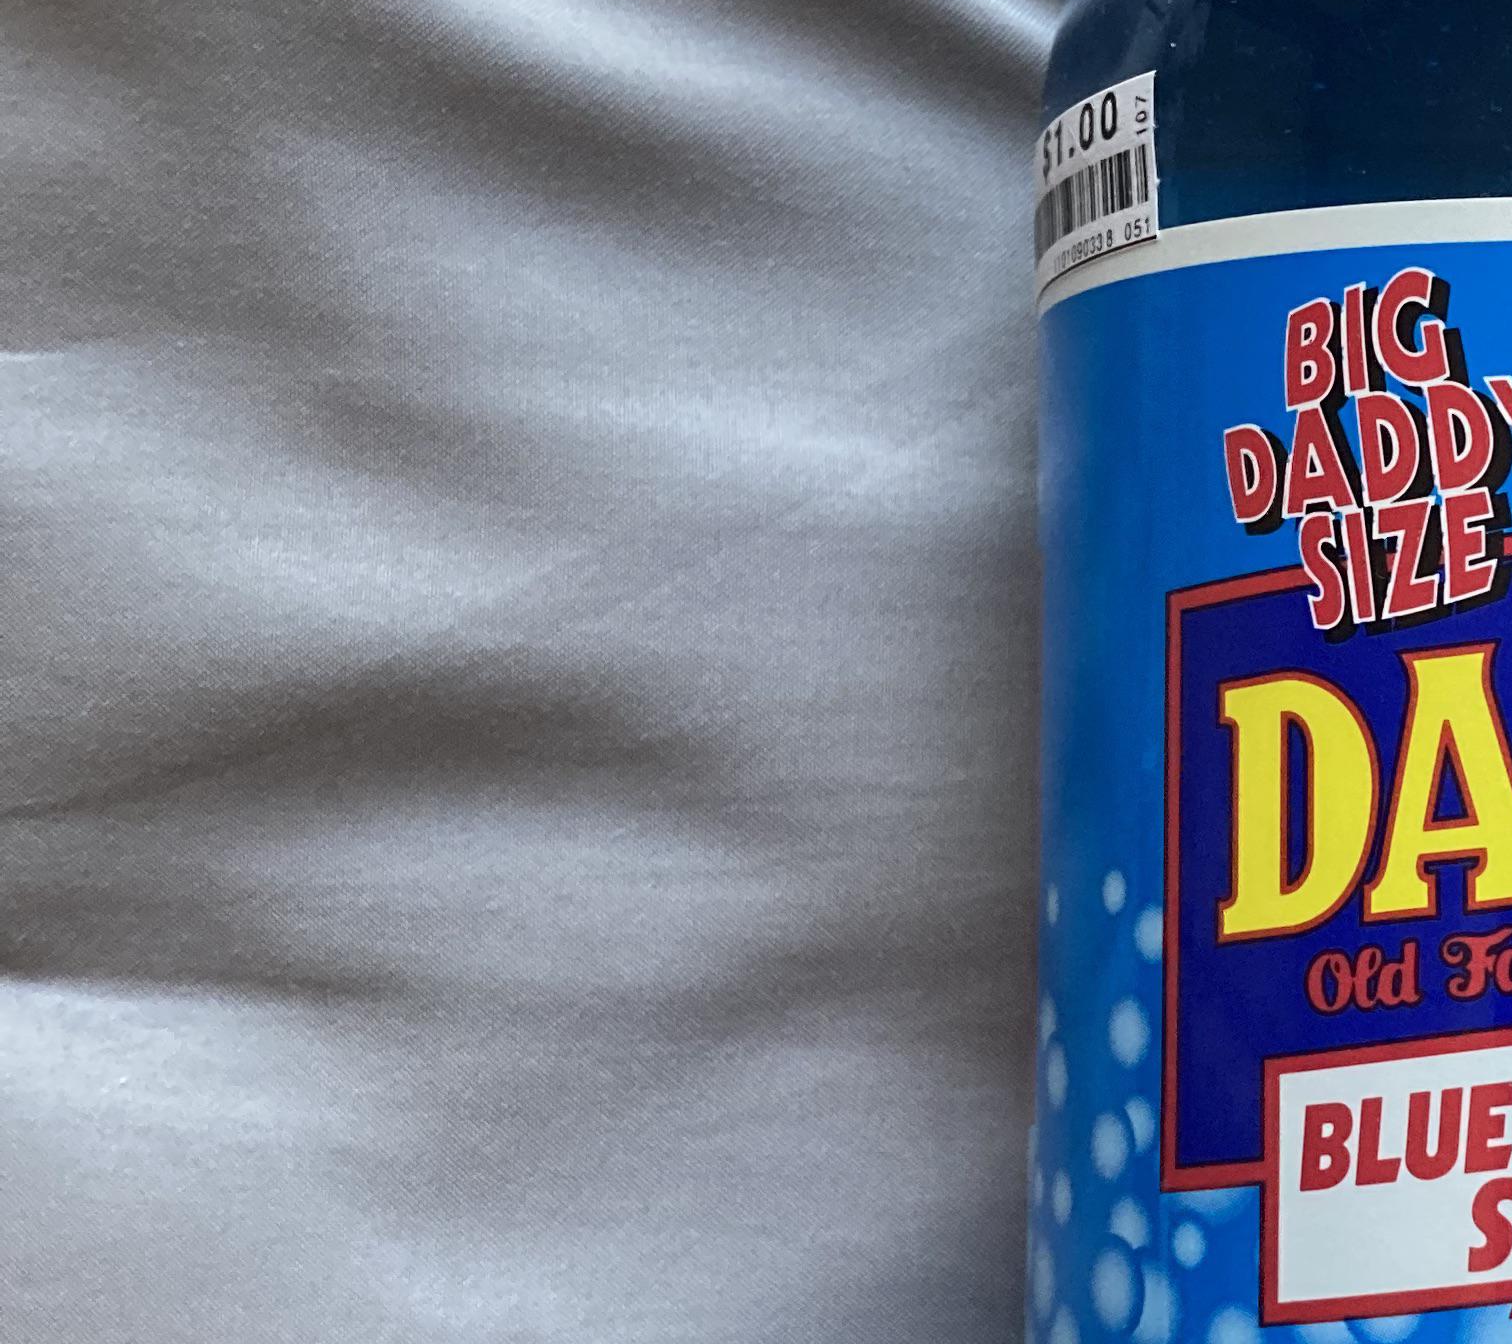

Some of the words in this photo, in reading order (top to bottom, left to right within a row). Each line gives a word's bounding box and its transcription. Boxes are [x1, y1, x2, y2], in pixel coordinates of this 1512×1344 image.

[1043, 92, 1117, 185] $1.00
[1285, 266, 1470, 412] BIG
[1299, 487, 1512, 642] SIZE
[1304, 937, 1421, 1014] Old
